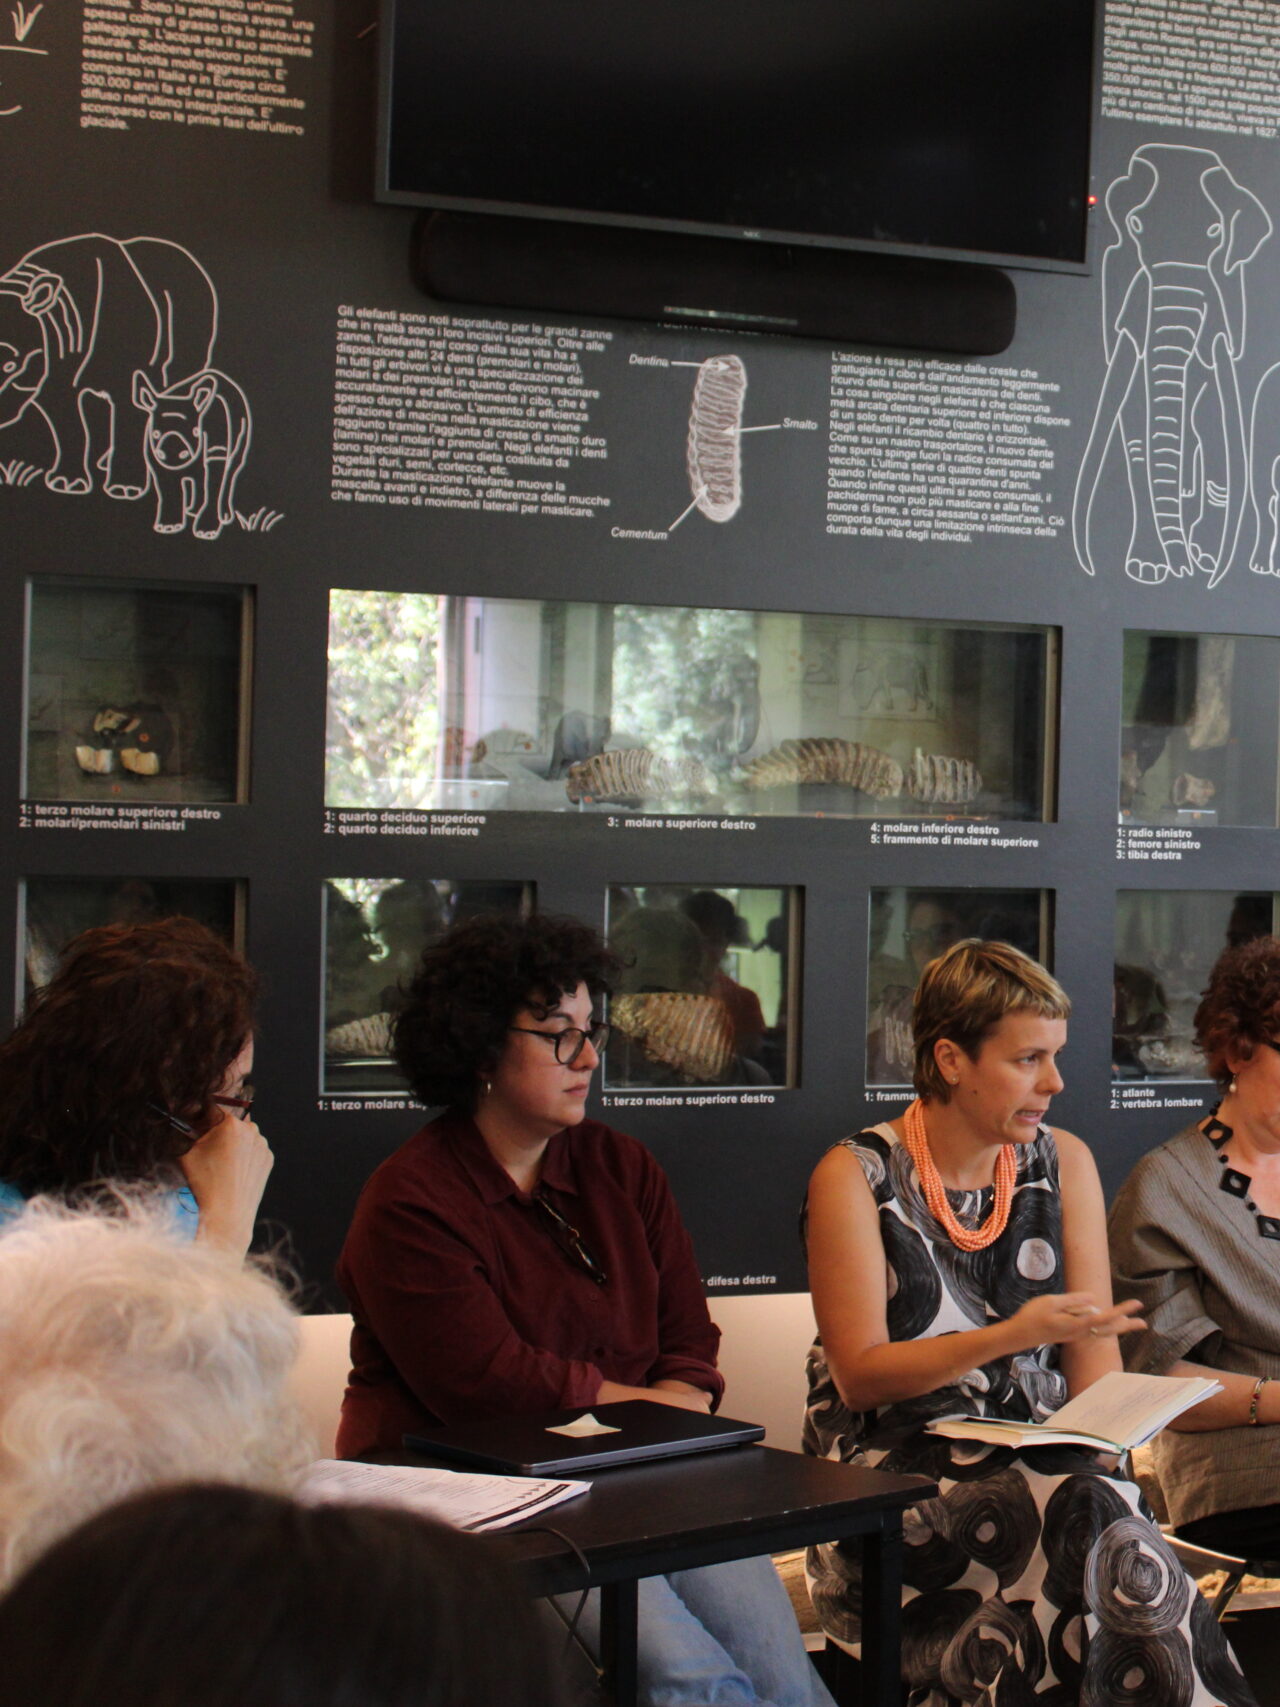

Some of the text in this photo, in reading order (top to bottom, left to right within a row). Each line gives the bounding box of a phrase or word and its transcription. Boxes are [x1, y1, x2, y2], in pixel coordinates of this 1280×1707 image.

[338, 306, 613, 341] Gli elefanti sono noti soprattutto per le grandi zanne
[629, 354, 670, 367] Dentina
[832, 352, 1039, 379] L'azione è resa più efficace dalle creste che
[783, 418, 818, 430] Smalto
[333, 454, 509, 476] vegetali duri, semi, cortecce, etc.
[331, 490, 594, 517] che fanno uso di movimenti laterali per masticare.
[611, 527, 668, 540] Cementum
[826, 524, 972, 543] durata della vita degli individui.
[21, 805, 221, 820] 1: terzo molare superiore destro
[20, 817, 185, 832] 2: molari/premolari sinistri
[327, 812, 486, 826] 1: quarto deciduo superiore
[608, 817, 756, 831] 3: molare superiore destro
[324, 824, 479, 836] 2: quarto deciduo inferiore
[871, 823, 1000, 834] 4: molare inferiore destro
[1117, 828, 1192, 838] 1: radio sinistro
[871, 834, 1039, 849] 5: frammento di molare superiore
[1116, 839, 1201, 849] 2: femore sinistro
[1116, 849, 1182, 860] 3: tibia destra
[865, 1092, 873, 1100] 1:
[1112, 1088, 1155, 1097] 1: atlante
[318, 1100, 328, 1110] 1:
[331, 1100, 362, 1110] terzo
[365, 1100, 405, 1109] molare
[602, 1095, 775, 1107] 1: terzo molare superiore destro
[1110, 1098, 1203, 1108] 2: vertebra lombare
[707, 1275, 776, 1286] difesa destra
